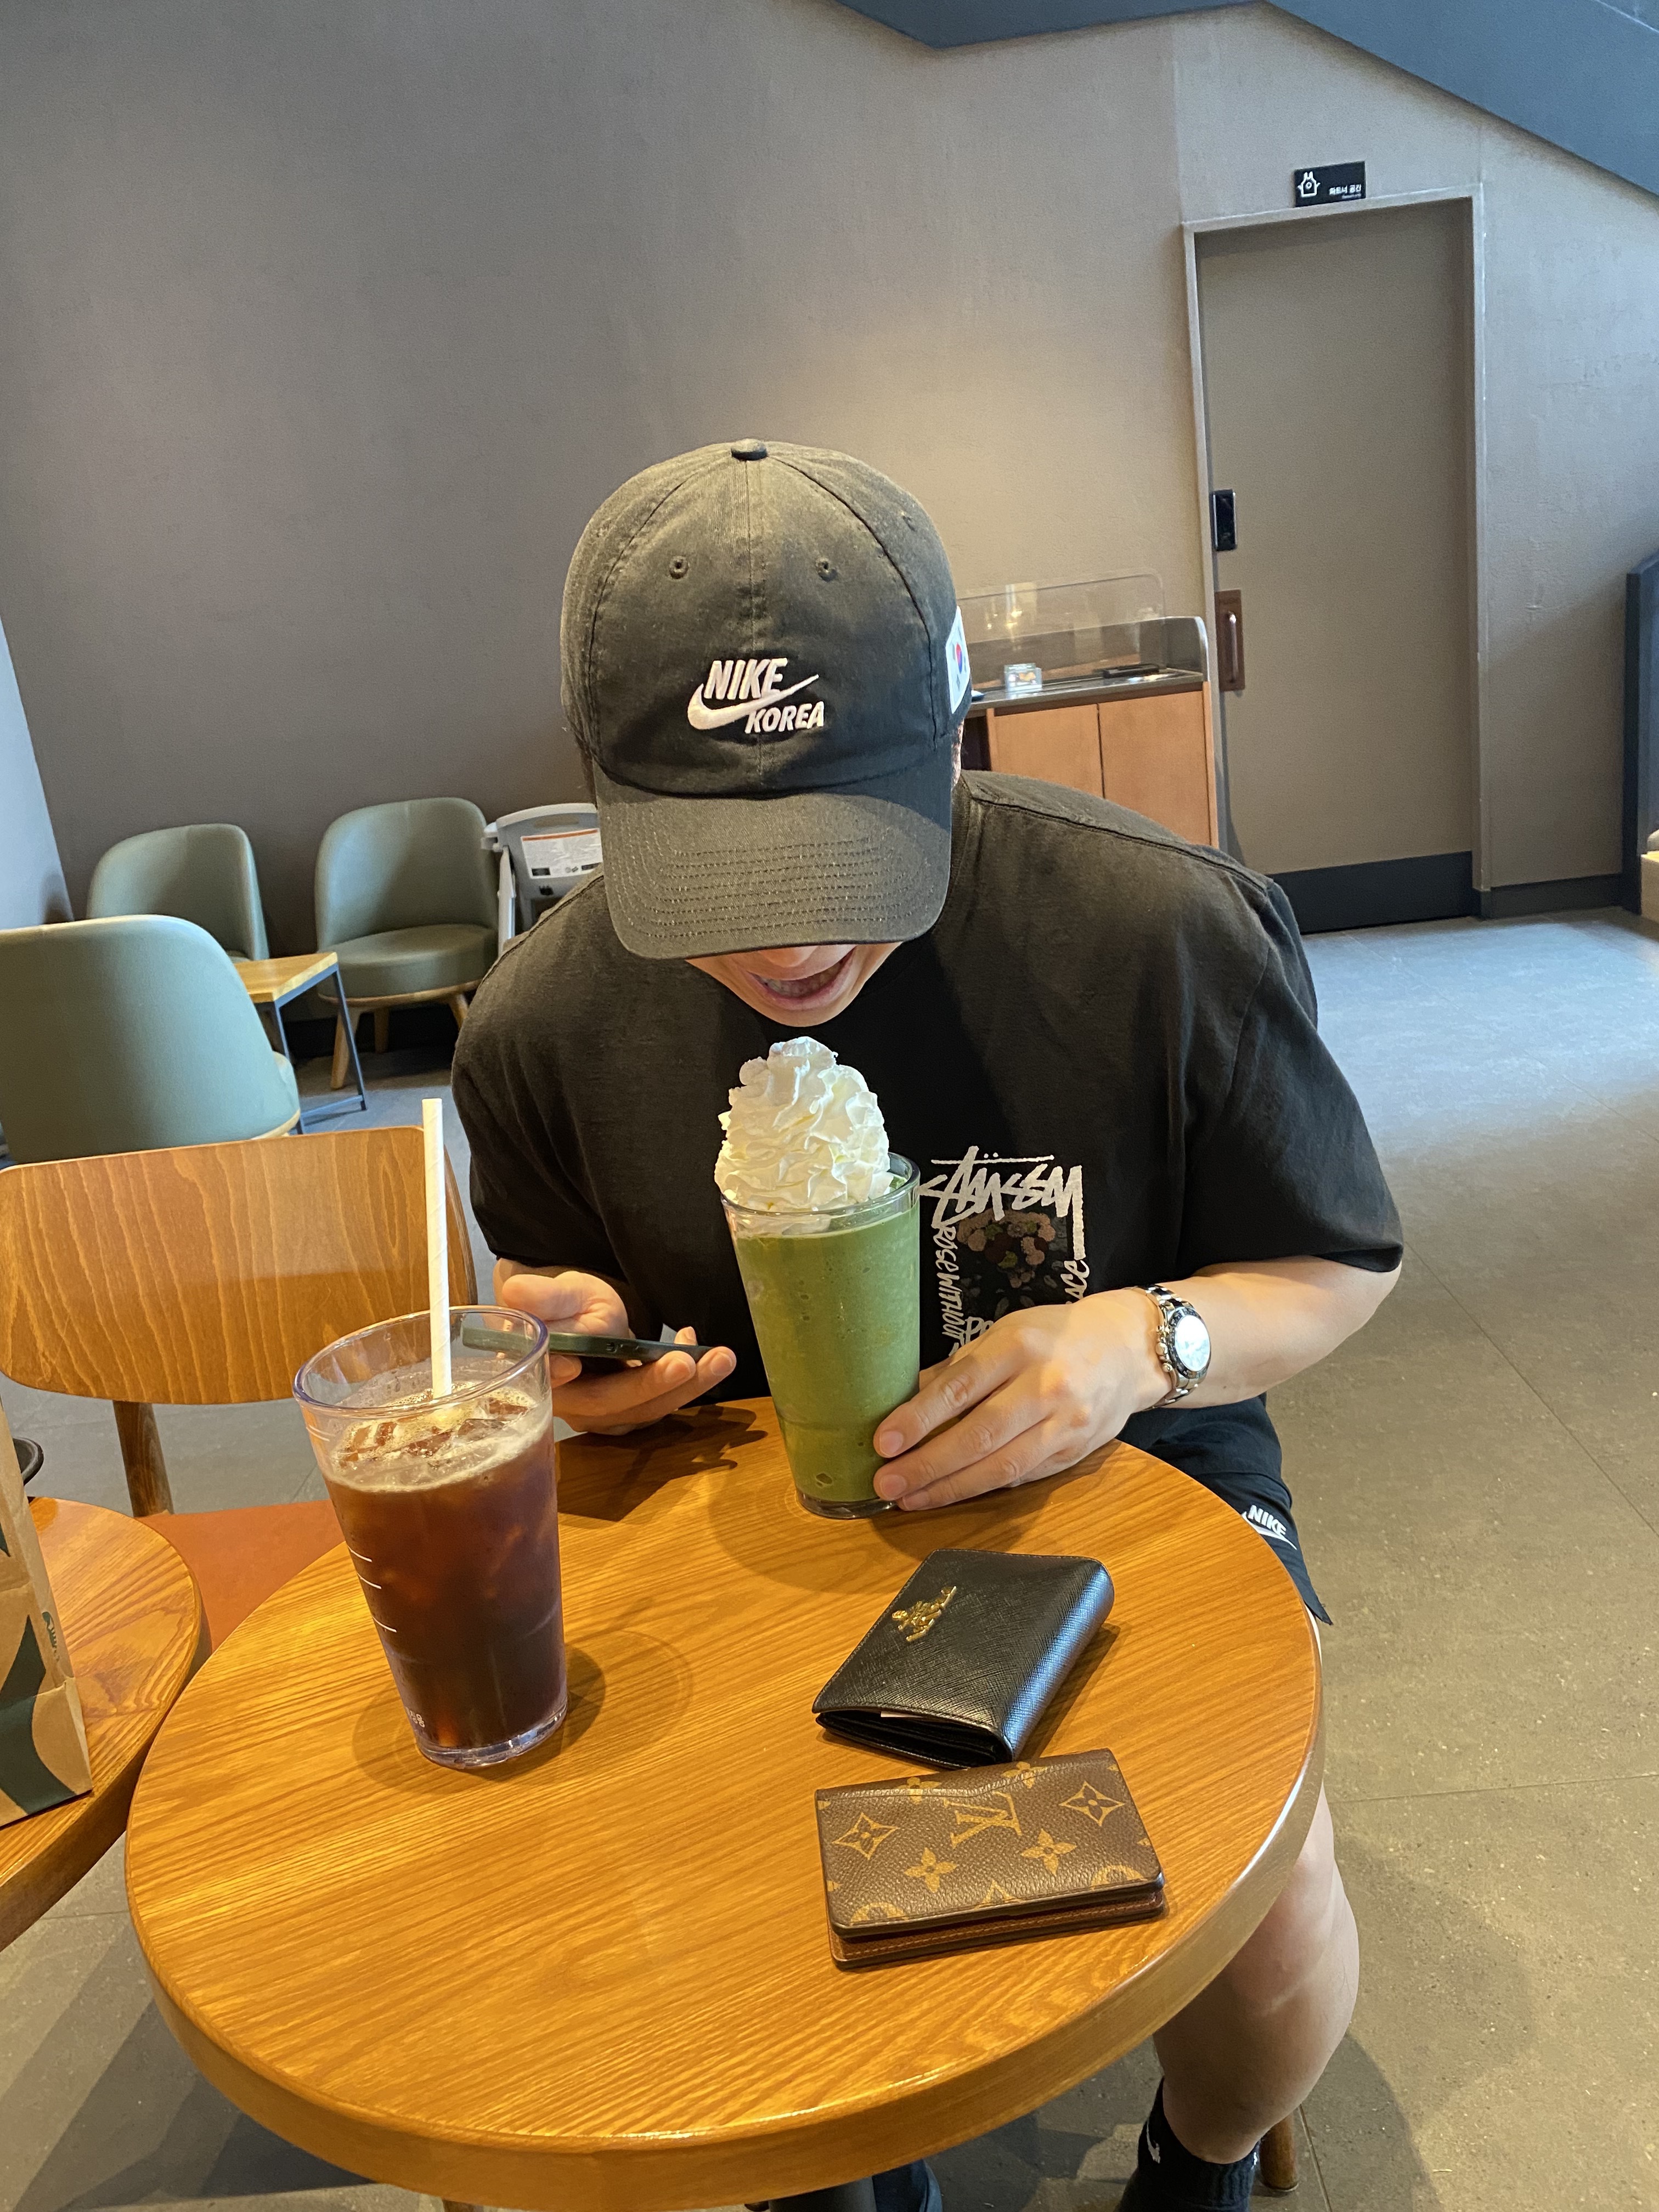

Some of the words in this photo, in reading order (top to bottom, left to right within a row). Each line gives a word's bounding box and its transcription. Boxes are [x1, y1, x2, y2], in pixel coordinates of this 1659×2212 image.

[1329, 186, 1348, 195] 파트너
[1350, 184, 1362, 193] 공간
[703, 657, 788, 699] NIKE
[744, 701, 825, 734] KOREA
[1248, 1504, 1287, 1536] NIKE
